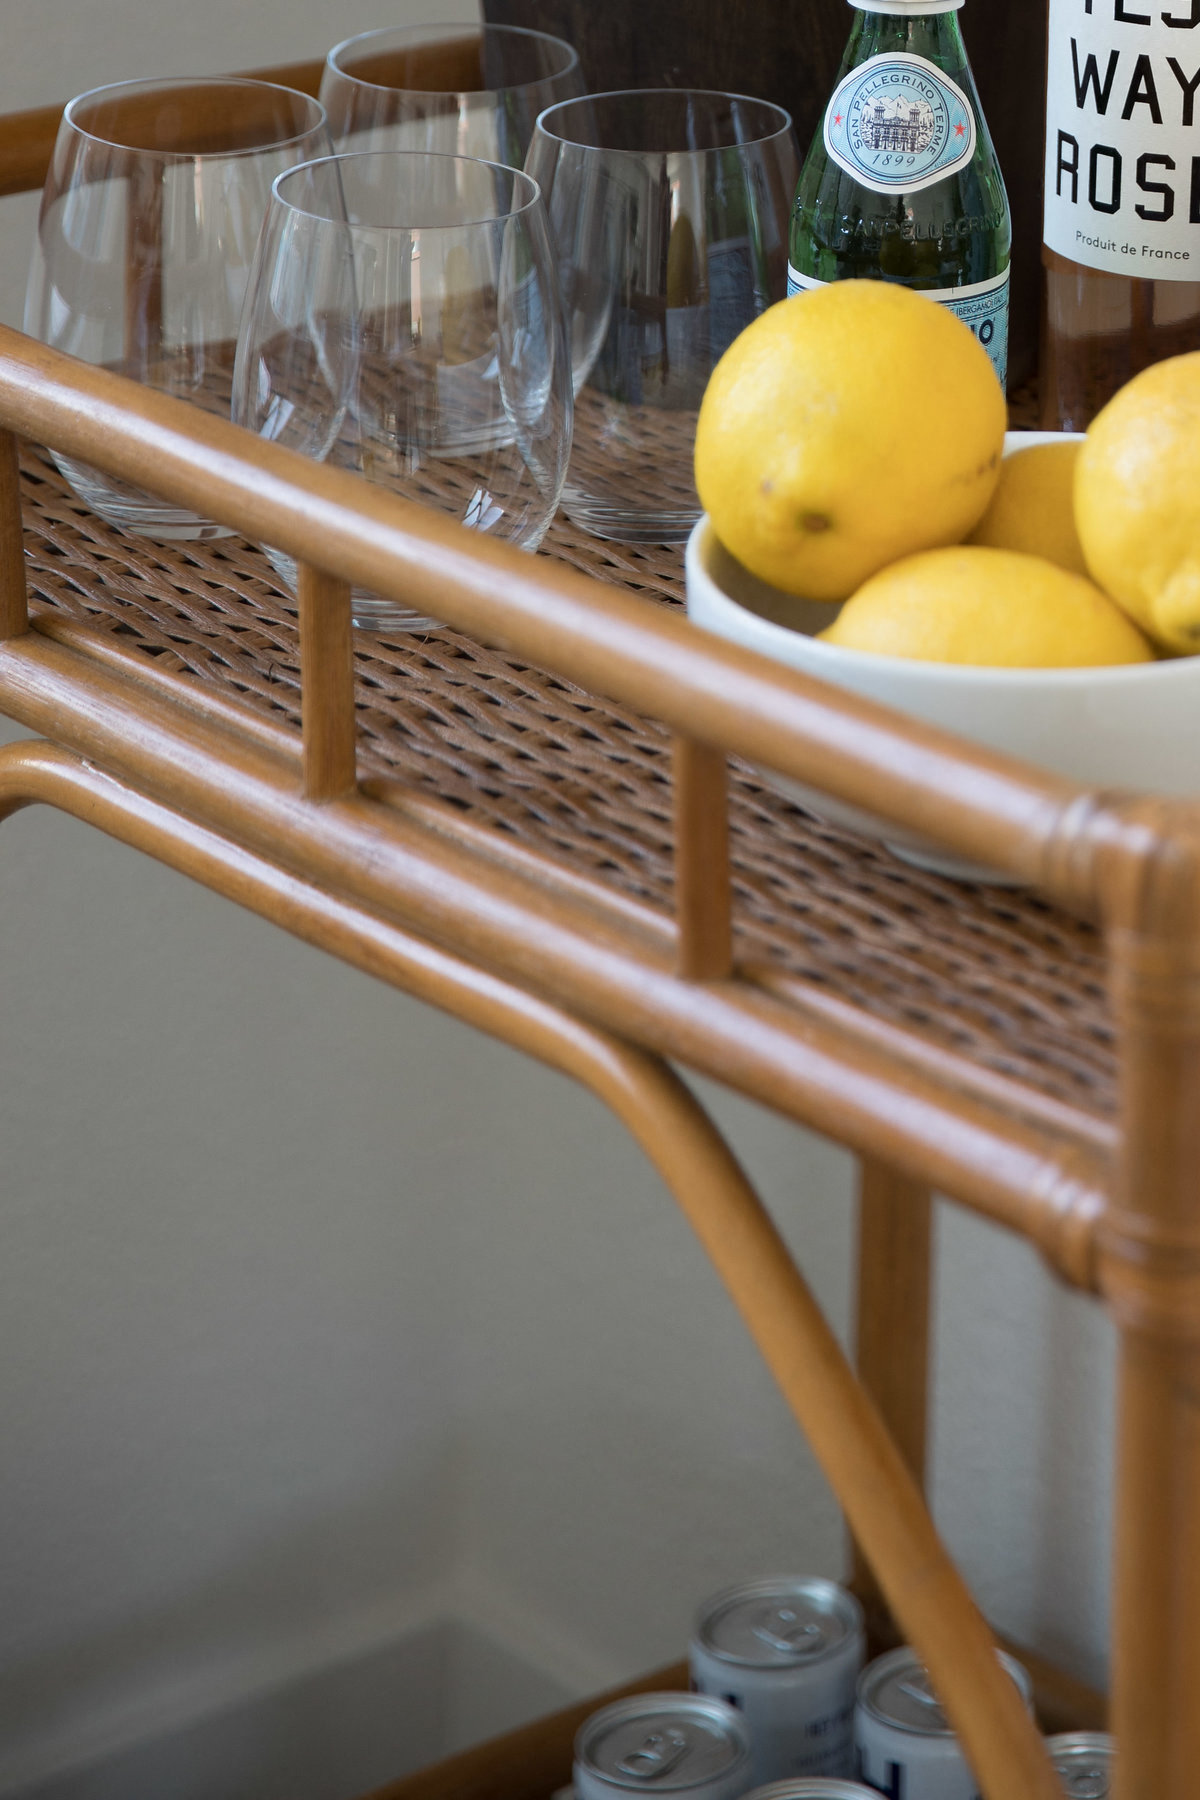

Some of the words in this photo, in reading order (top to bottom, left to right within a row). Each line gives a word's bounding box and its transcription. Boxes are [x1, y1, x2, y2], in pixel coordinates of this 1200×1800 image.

[854, 74, 935, 112] PELLEGRINO
[851, 119, 864, 150] SAN
[926, 102, 945, 156] TERME
[871, 153, 916, 168] 1899
[1075, 230, 1117, 252] Produit
[1120, 243, 1137, 256] de
[1141, 245, 1190, 261] France
